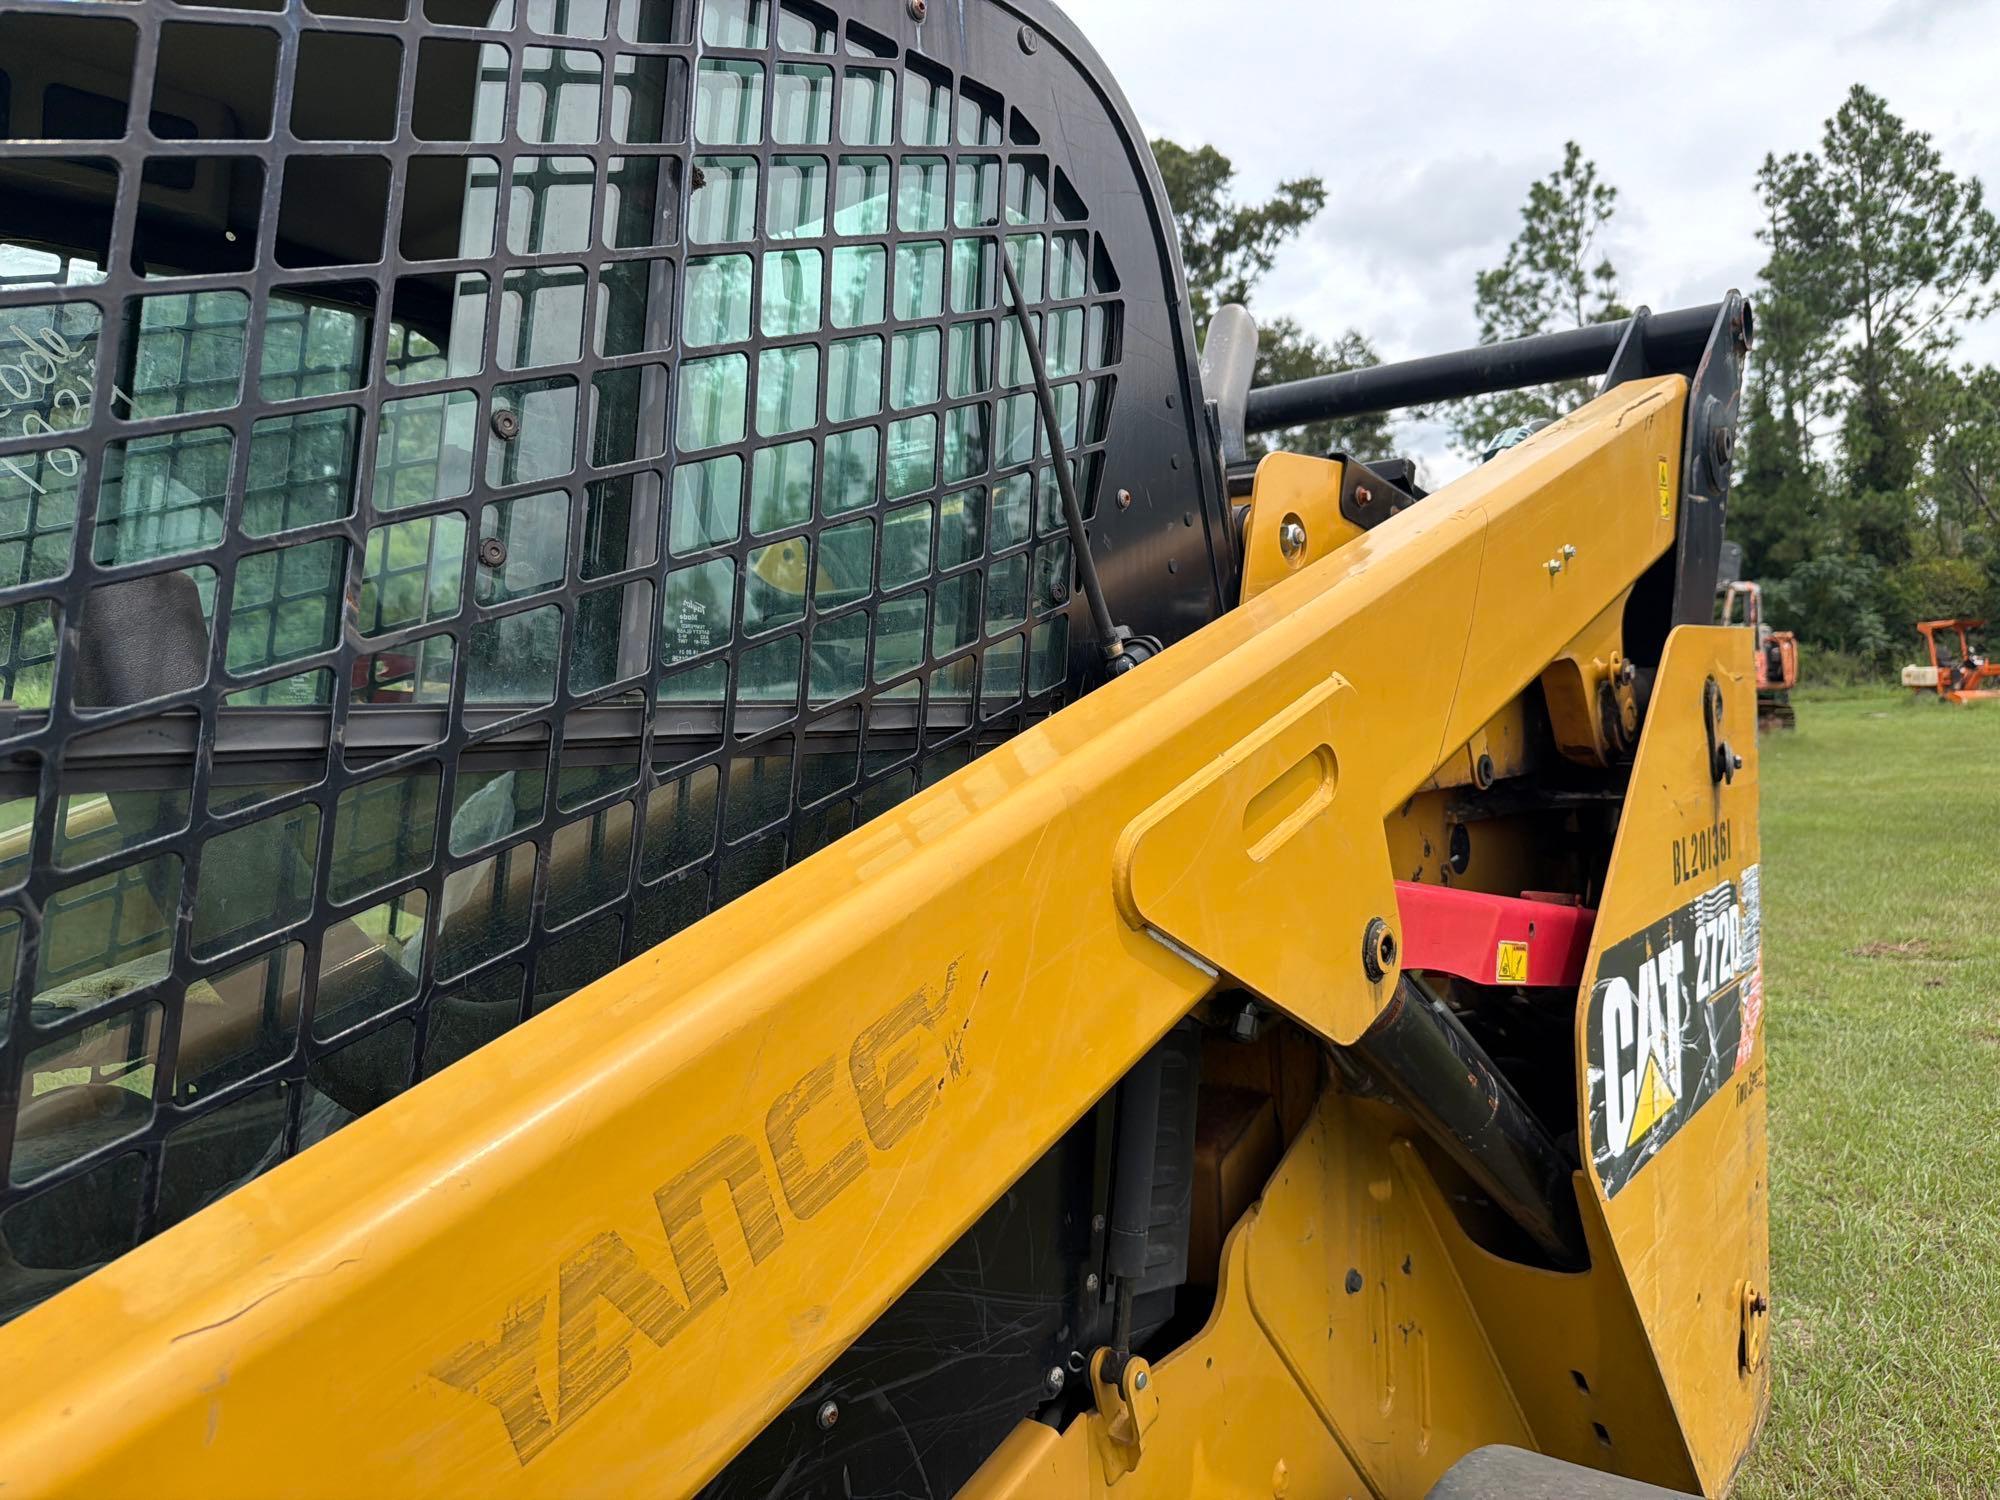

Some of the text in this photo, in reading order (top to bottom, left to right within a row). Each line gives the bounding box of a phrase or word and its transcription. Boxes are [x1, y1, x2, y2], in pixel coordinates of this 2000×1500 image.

[0, 325, 86, 419] ode
[1673, 818, 1731, 886] BL201361
[1602, 940, 1684, 1157] CAT
